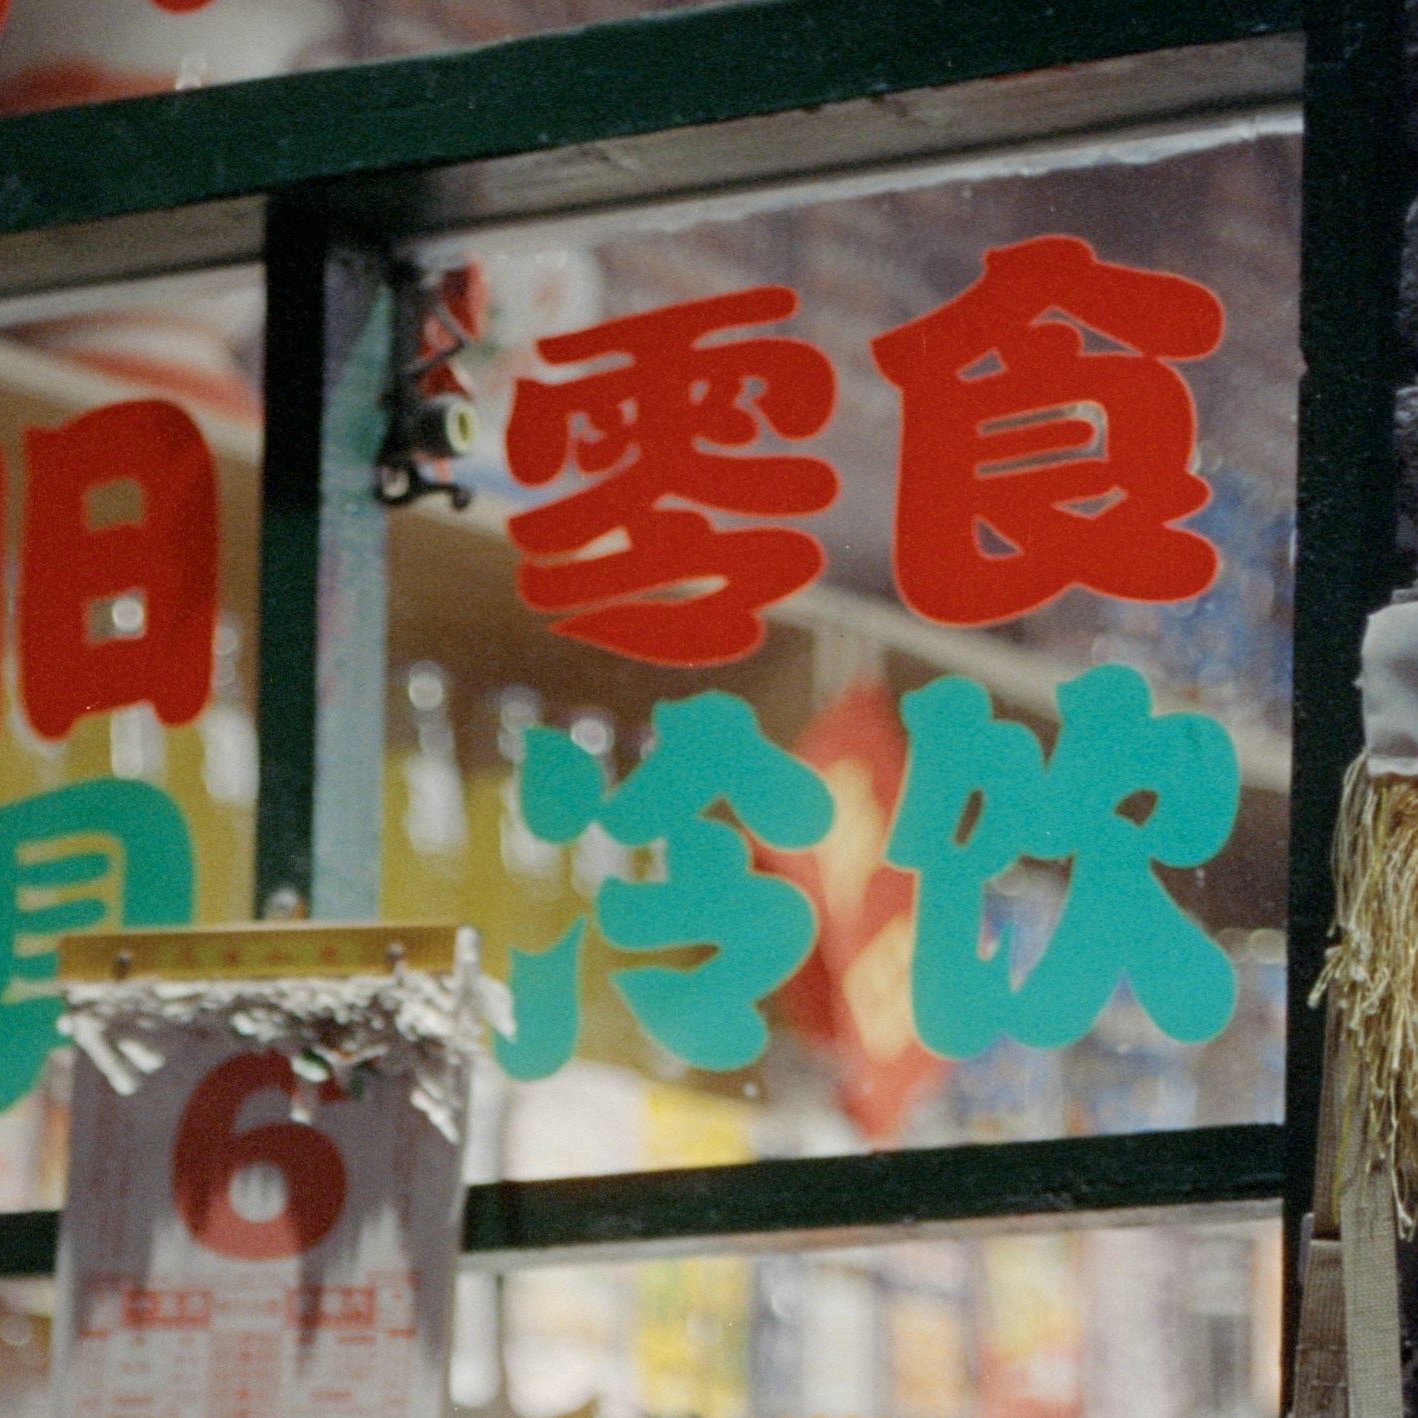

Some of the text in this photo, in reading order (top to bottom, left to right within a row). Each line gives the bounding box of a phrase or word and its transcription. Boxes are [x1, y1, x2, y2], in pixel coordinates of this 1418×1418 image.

[505, 234, 1224, 666] 零食
[491, 663, 1240, 1081] 冷饮
[172, 1047, 350, 1262] 6
